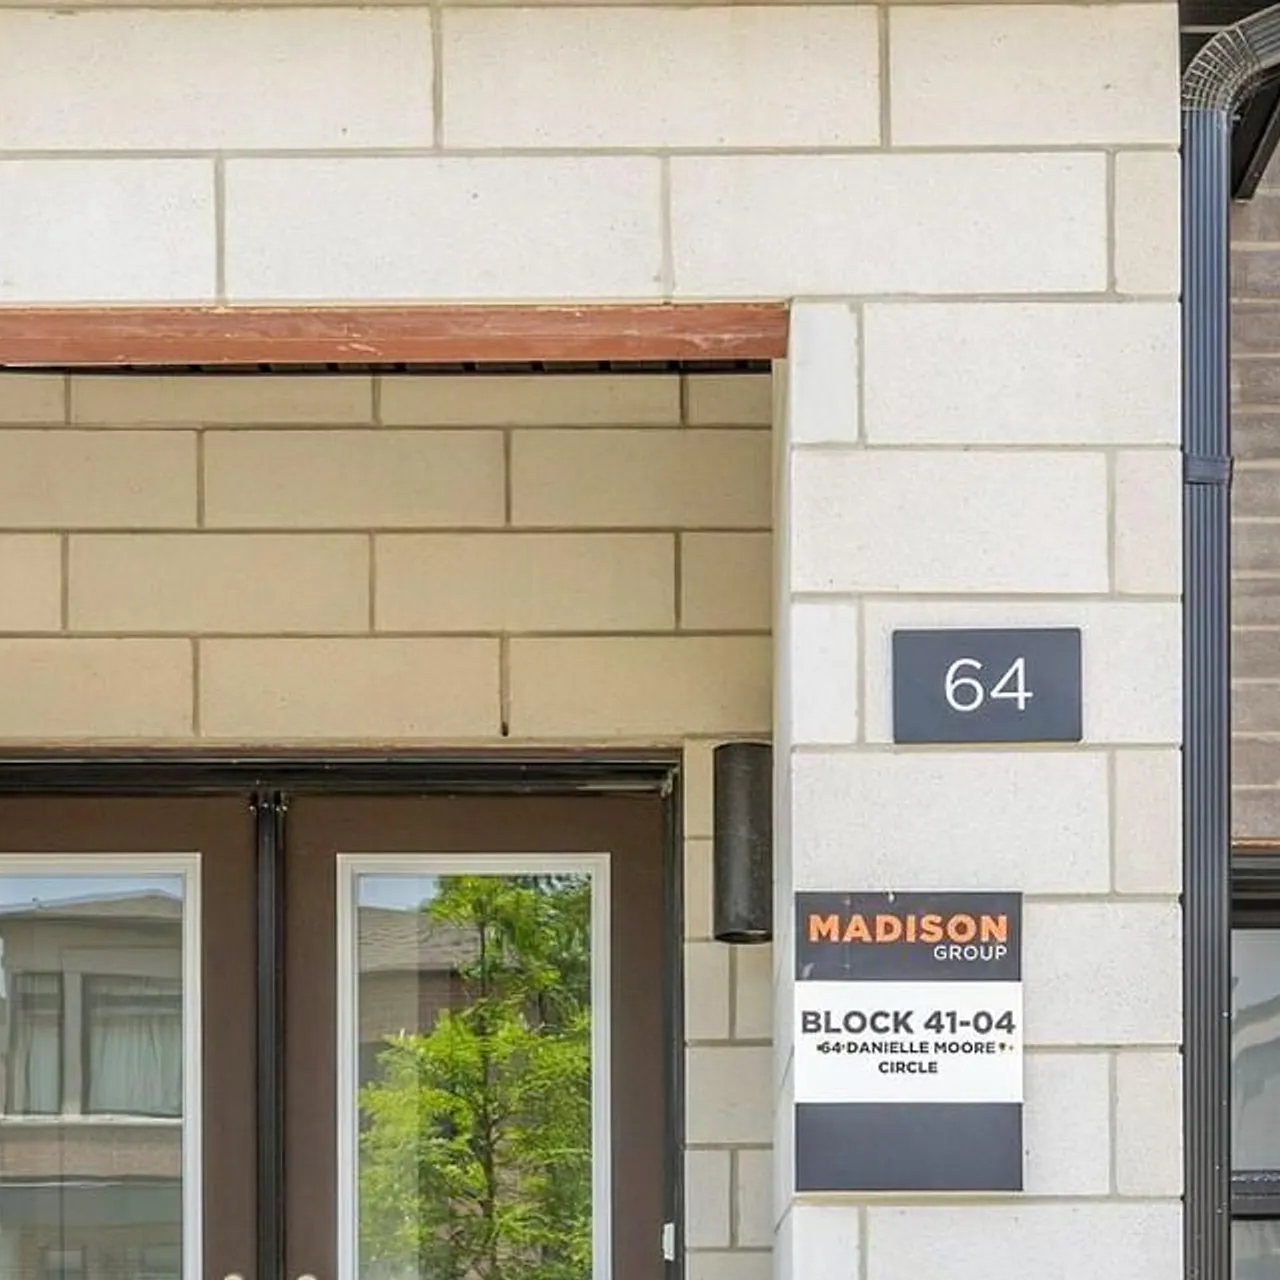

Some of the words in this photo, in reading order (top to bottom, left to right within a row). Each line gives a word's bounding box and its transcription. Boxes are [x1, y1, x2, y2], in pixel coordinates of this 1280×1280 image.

[943, 656, 1034, 712] 64
[808, 913, 1009, 943] MADISON
[933, 945, 1008, 961] GROUP
[801, 1010, 915, 1035] BLOCK
[923, 1010, 1016, 1035] 41-04
[846, 1041, 929, 1054] DANIELLE
[933, 1041, 996, 1054] MOORE
[877, 1060, 939, 1074] CIRCLE
